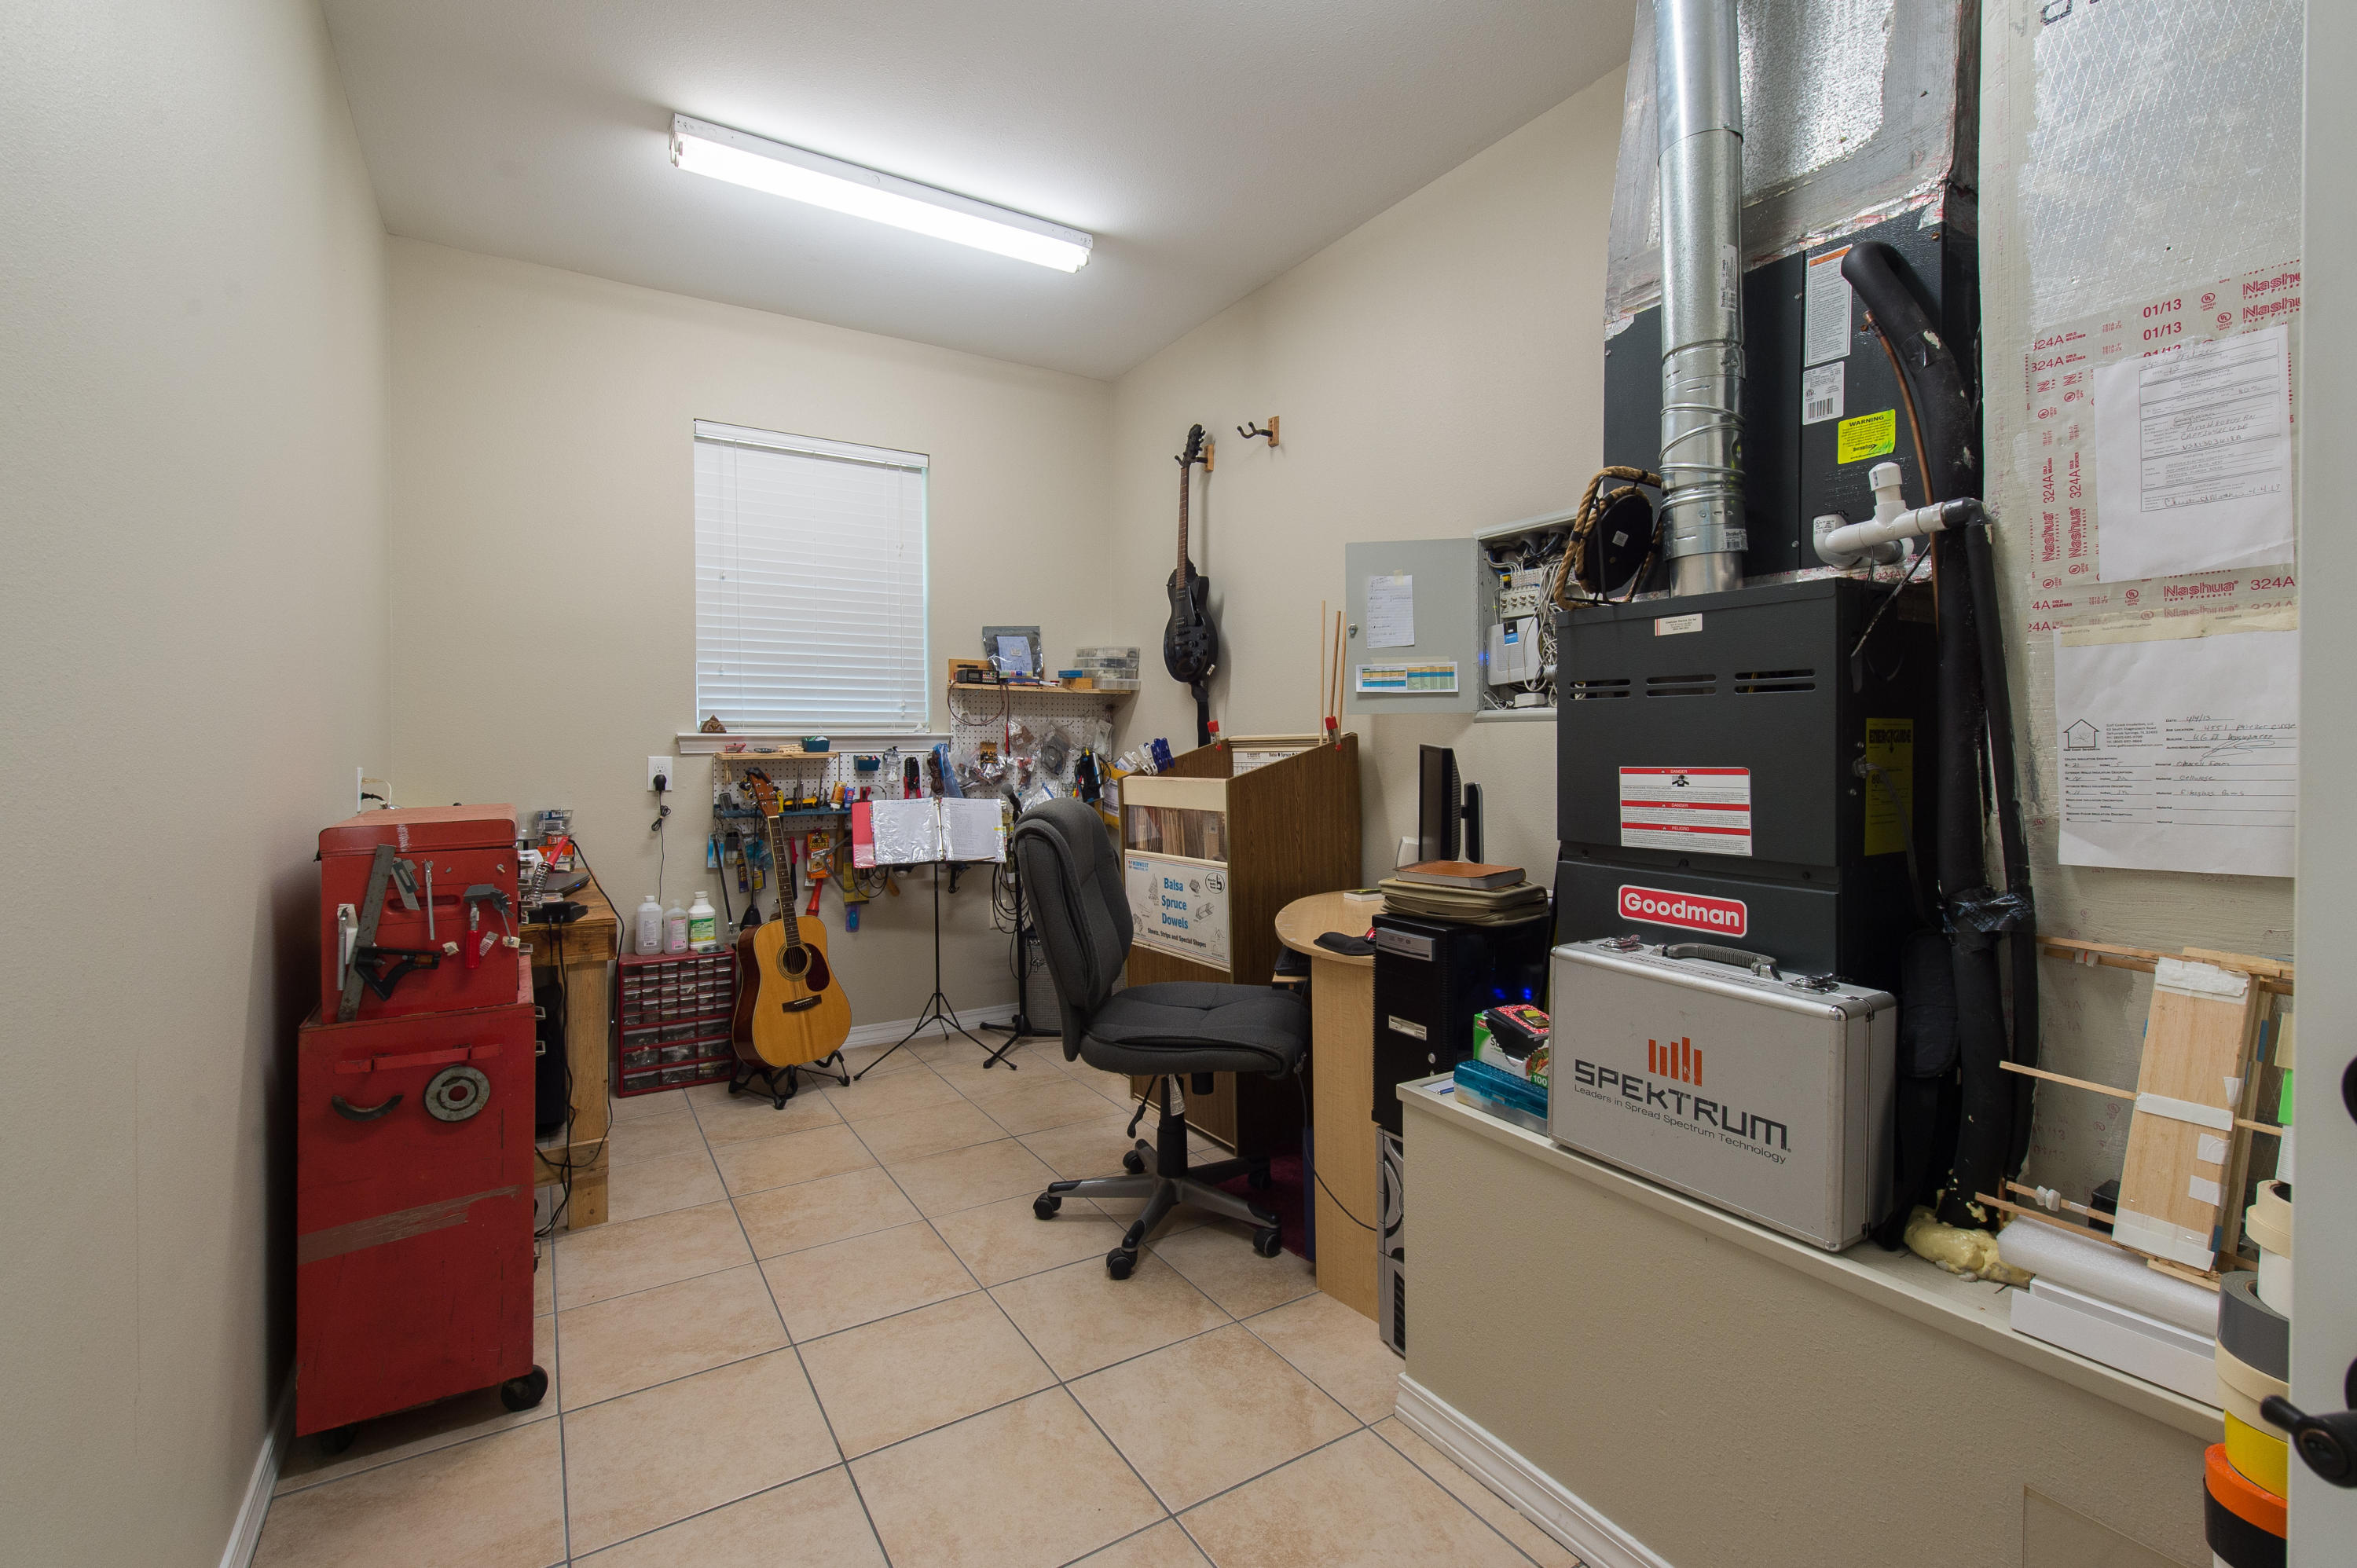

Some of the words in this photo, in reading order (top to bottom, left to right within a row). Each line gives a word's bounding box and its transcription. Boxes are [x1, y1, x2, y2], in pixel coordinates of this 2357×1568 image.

[2143, 299, 2182, 318] 01/13
[2143, 321, 2182, 341] 01/13
[2031, 357, 2064, 372] 324A
[1849, 415, 1884, 427] WARNING
[2043, 474, 2055, 504] 324A
[2069, 469, 2081, 499] 324A
[2042, 512, 2055, 562] Nashua
[2068, 507, 2082, 558] Nashua
[2163, 581, 2236, 599] Nashua
[2250, 576, 2296, 591] 324A
[1164, 877, 1183, 892] Balsa
[1161, 895, 1187, 910] Spruce
[1624, 892, 1739, 928] Goodman
[1161, 913, 1189, 929] Dowels
[1178, 936, 1193, 944] Special
[1533, 1075, 1548, 1086] 100
[1575, 1058, 1788, 1151] SPEKTRUM
[1574, 1084, 1611, 1105] Leaders
[1615, 1098, 1622, 1108] in
[1625, 1101, 1661, 1122] Spread
[1663, 1112, 1715, 1141] Spectrum
[1718, 1133, 1787, 1165] Technology
